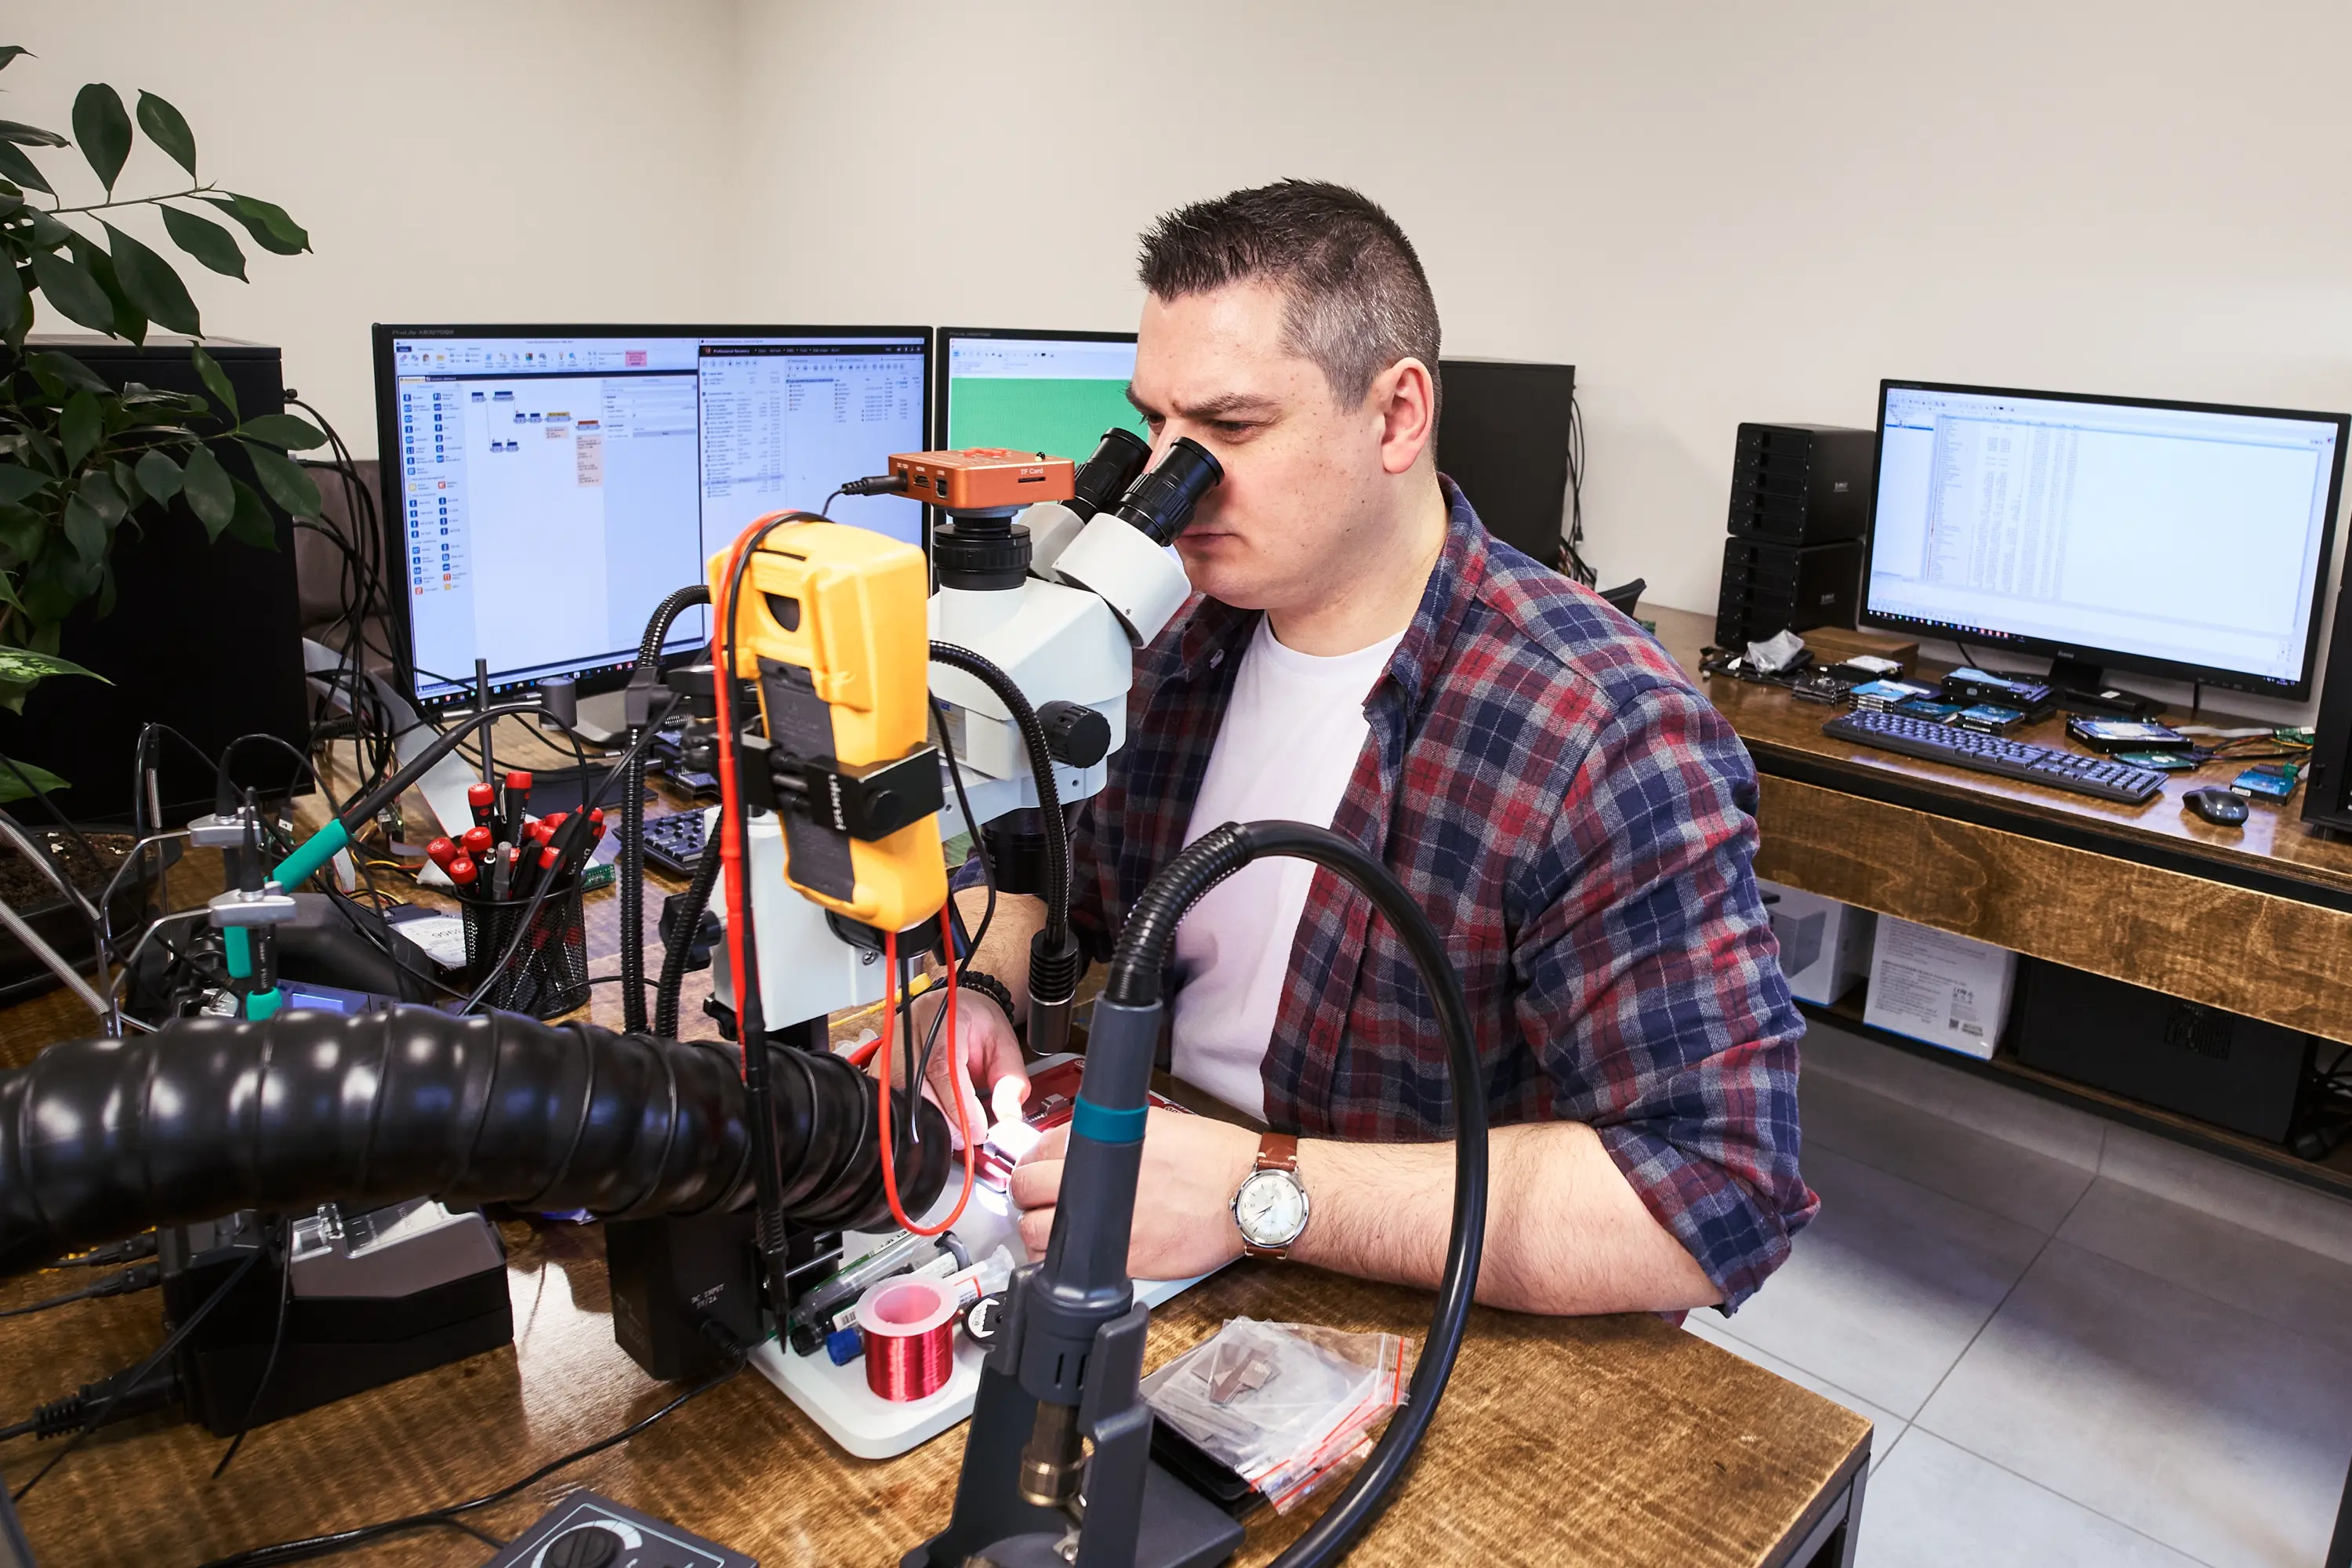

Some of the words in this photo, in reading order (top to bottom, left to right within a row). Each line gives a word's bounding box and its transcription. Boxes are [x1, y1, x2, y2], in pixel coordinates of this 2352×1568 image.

[828, 774, 847, 831] ulanzi
[691, 1294, 701, 1304] DC
[704, 1283, 724, 1298] INPUT
